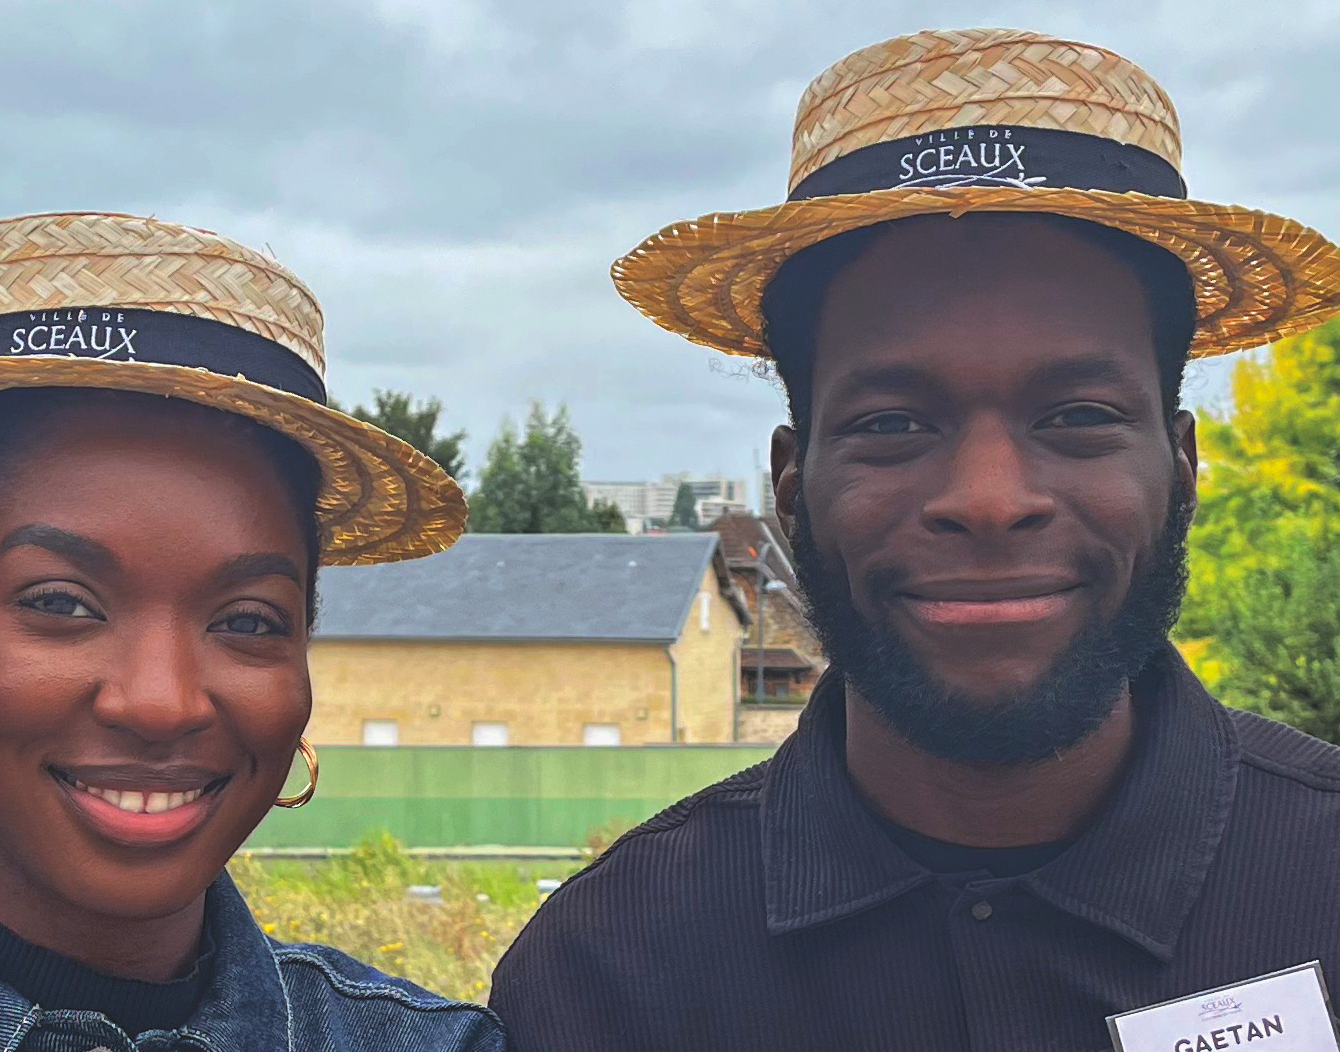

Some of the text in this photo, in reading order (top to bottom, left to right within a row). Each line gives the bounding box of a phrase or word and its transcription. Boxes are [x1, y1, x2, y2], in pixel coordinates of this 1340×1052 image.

[915, 129, 1012, 146] VILLE DE
[899, 142, 1025, 180] SCEAUX
[102, 312, 124, 323] DE
[11, 325, 137, 355] SCEAUX
